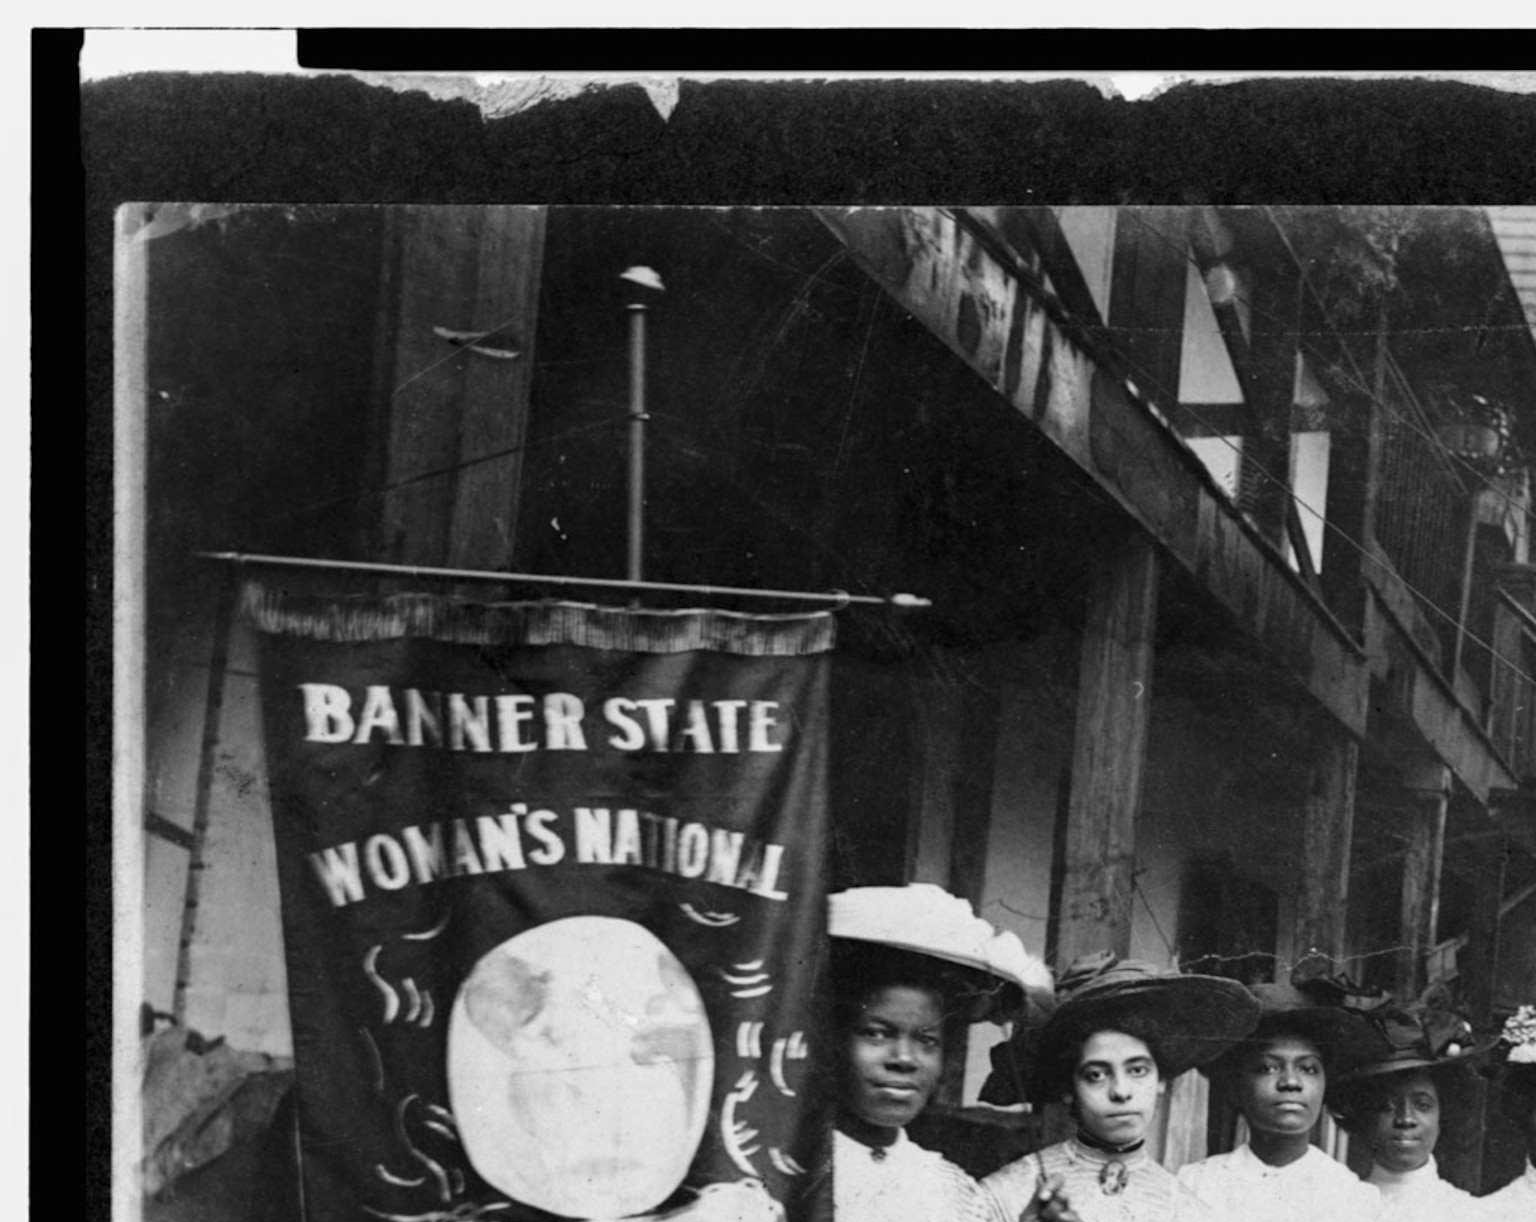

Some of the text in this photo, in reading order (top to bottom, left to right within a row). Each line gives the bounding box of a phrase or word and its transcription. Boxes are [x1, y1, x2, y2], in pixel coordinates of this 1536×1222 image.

[298, 683, 782, 753] BANNER STATE
[310, 803, 788, 907] WOMAN'S NATIONAL
